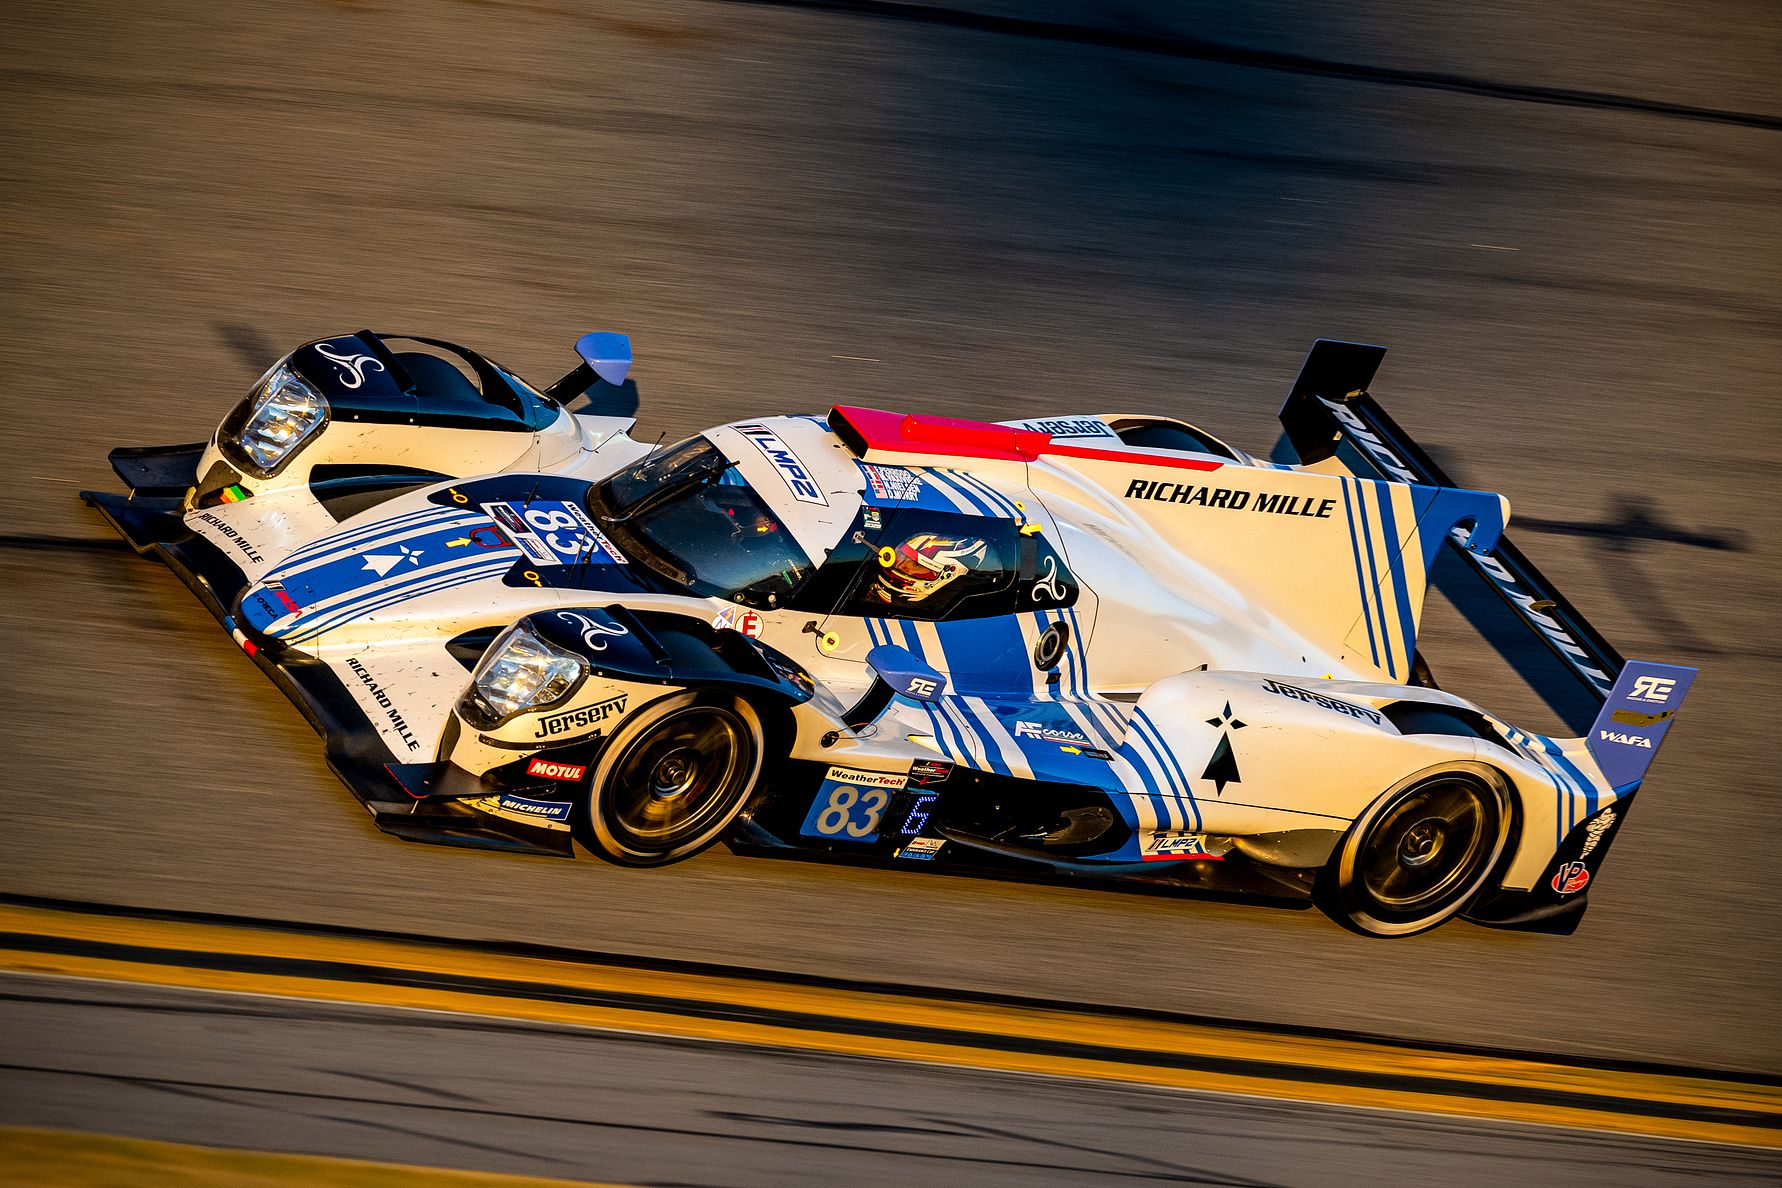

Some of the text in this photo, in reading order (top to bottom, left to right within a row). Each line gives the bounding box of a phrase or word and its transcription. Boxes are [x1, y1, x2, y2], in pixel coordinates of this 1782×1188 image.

[754, 437, 819, 498] LMP2
[1124, 479, 1337, 519] RICHARD MILLE
[200, 512, 264, 564] RICHARD MILLE
[525, 509, 599, 555] 83
[568, 503, 626, 562] WeatherTech
[345, 657, 420, 752] RICHARD MILLE
[535, 693, 629, 739] Jerserv
[1262, 679, 1381, 725] Jerserv
[1042, 728, 1084, 740] corse
[1600, 729, 1652, 749] WAFA
[530, 762, 581, 779] MOTUL
[831, 769, 906, 786] WeatherTech
[501, 799, 563, 816] MICHELIN
[816, 786, 888, 838] 83
[1557, 861, 1586, 891] VP
